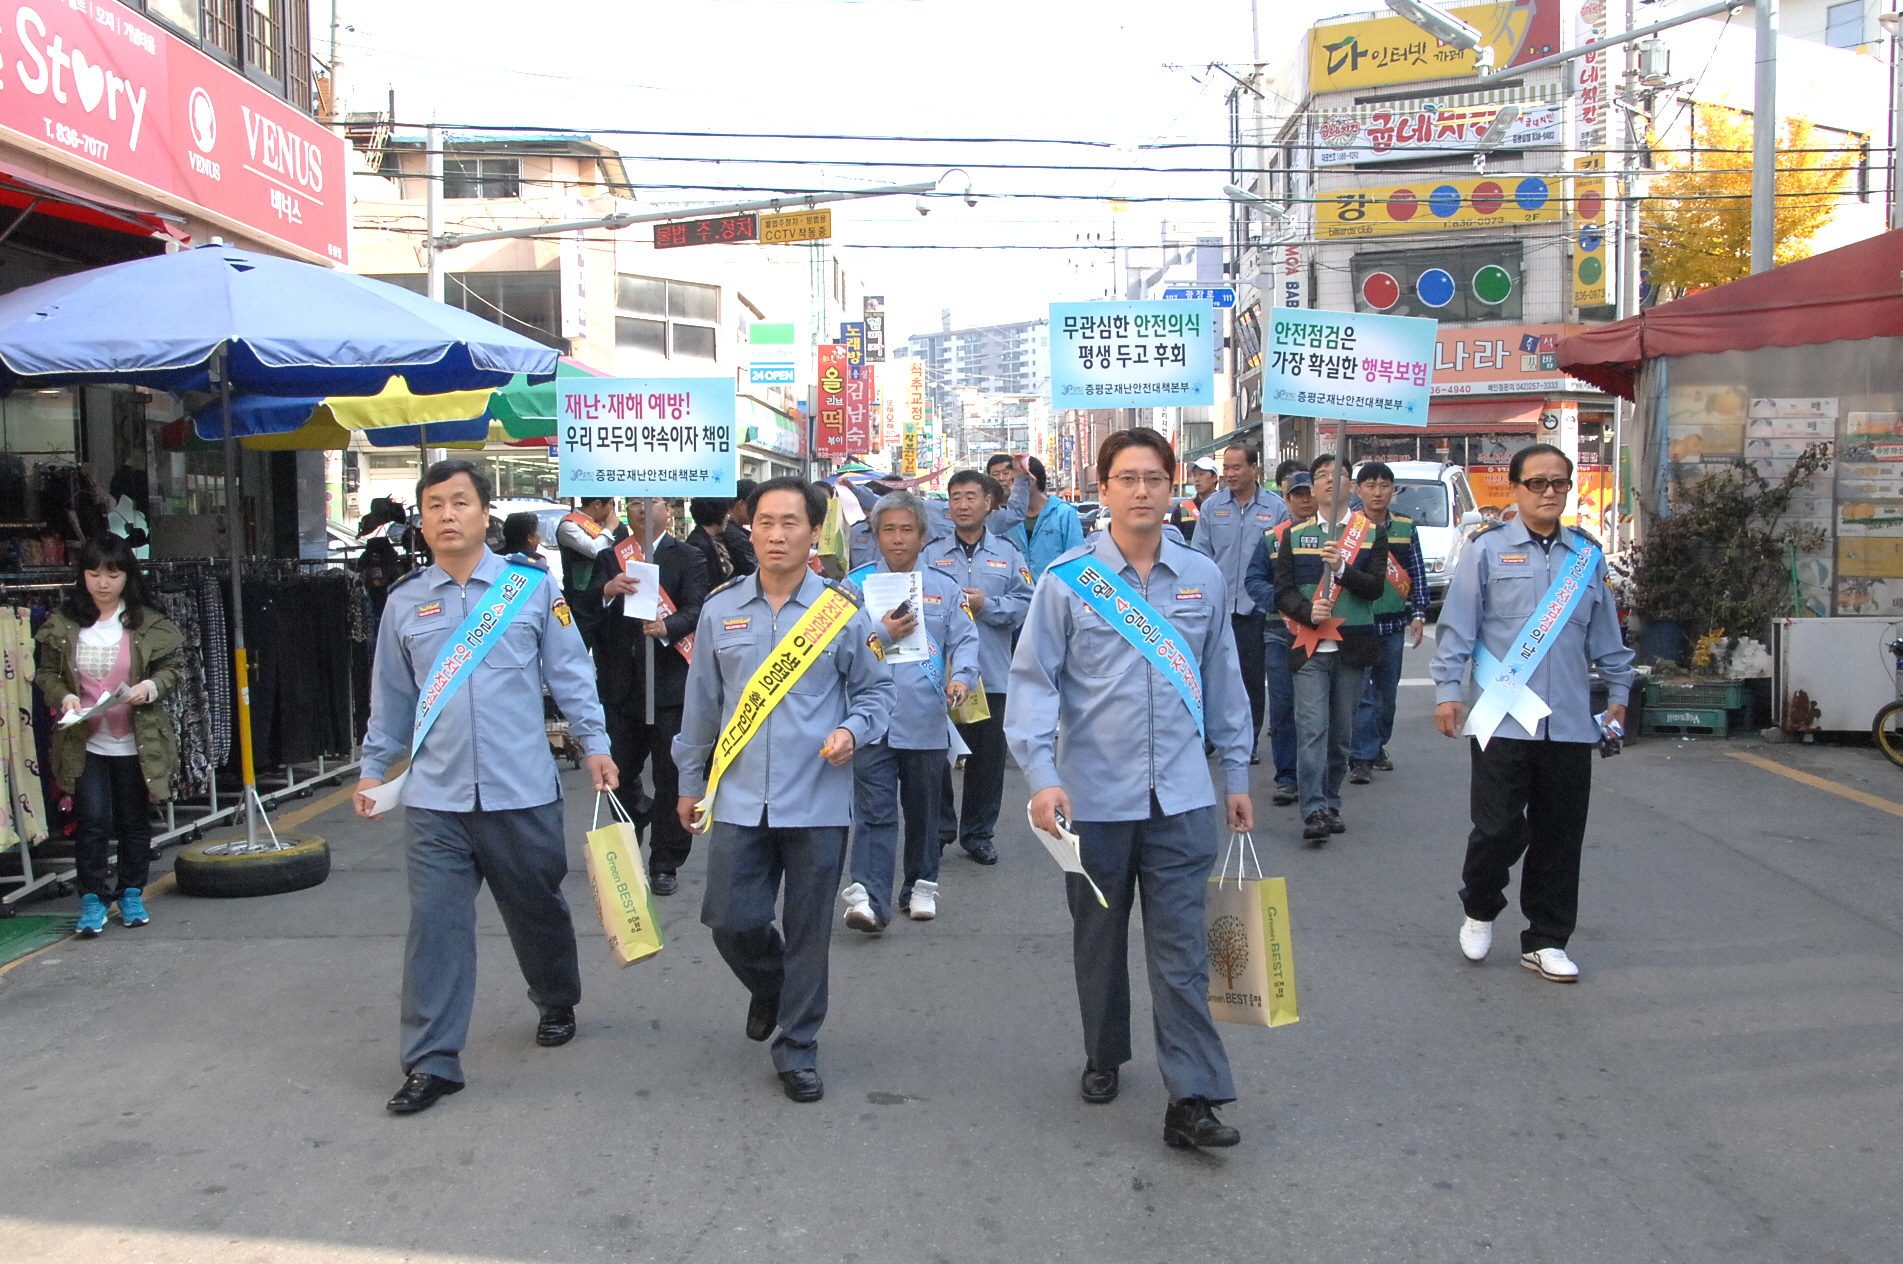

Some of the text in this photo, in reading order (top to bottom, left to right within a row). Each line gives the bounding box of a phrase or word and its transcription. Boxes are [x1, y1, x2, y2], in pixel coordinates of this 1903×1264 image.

[1322, 36, 1368, 76] 다
[1372, 42, 1428, 68] 인터넷
[241, 105, 323, 192] VENUS
[188, 151, 221, 181] VENUS
[270, 188, 302, 224] 비너스
[1336, 193, 1366, 222] 킹
[1524, 213, 1540, 223] 2F
[657, 224, 686, 246] 불법
[765, 229, 796, 241] CCTV
[1357, 225, 1374, 235] club
[1185, 289, 1214, 300] 광장로
[1222, 294, 1233, 302] 111
[1575, 289, 1606, 302] 836-0973
[1063, 313, 1200, 340] 무관심한 안전의식
[1275, 321, 1357, 351] 안전점검은
[846, 324, 863, 365] 노래방
[1079, 343, 1186, 369] 평생 두고 후회
[1434, 340, 1512, 372] 나라
[765, 370, 794, 381] OPEN
[1272, 351, 1428, 387] 가장 확실한 행복보험
[910, 362, 924, 421] 척추교정
[1085, 382, 1190, 396] 증평군재난안전대책본부
[1297, 391, 1403, 410] 증평군재난안전대책본부
[1487, 383, 1515, 392] 체인점문의
[565, 392, 690, 420] 재난·재해 예방!
[848, 380, 867, 447] 김남숙
[565, 425, 730, 452] 우리 모두의 약속이자 책임
[596, 469, 709, 482] 증평군재난안전대책본부
[503, 572, 528, 603] 매월
[1077, 567, 1116, 600] 매월
[1115, 597, 1162, 645] 4일은
[1530, 577, 1578, 644] 안전점검의
[466, 602, 506, 647] 4일은
[1520, 642, 1538, 660] 날
[721, 592, 851, 757] 안전점검이 생명의 확인입니다
[606, 851, 621, 883] Green
[617, 882, 637, 914] BEST
[1267, 906, 1278, 942] Green
[1271, 943, 1283, 978] BEST
[1226, 992, 1248, 1004] BEST
